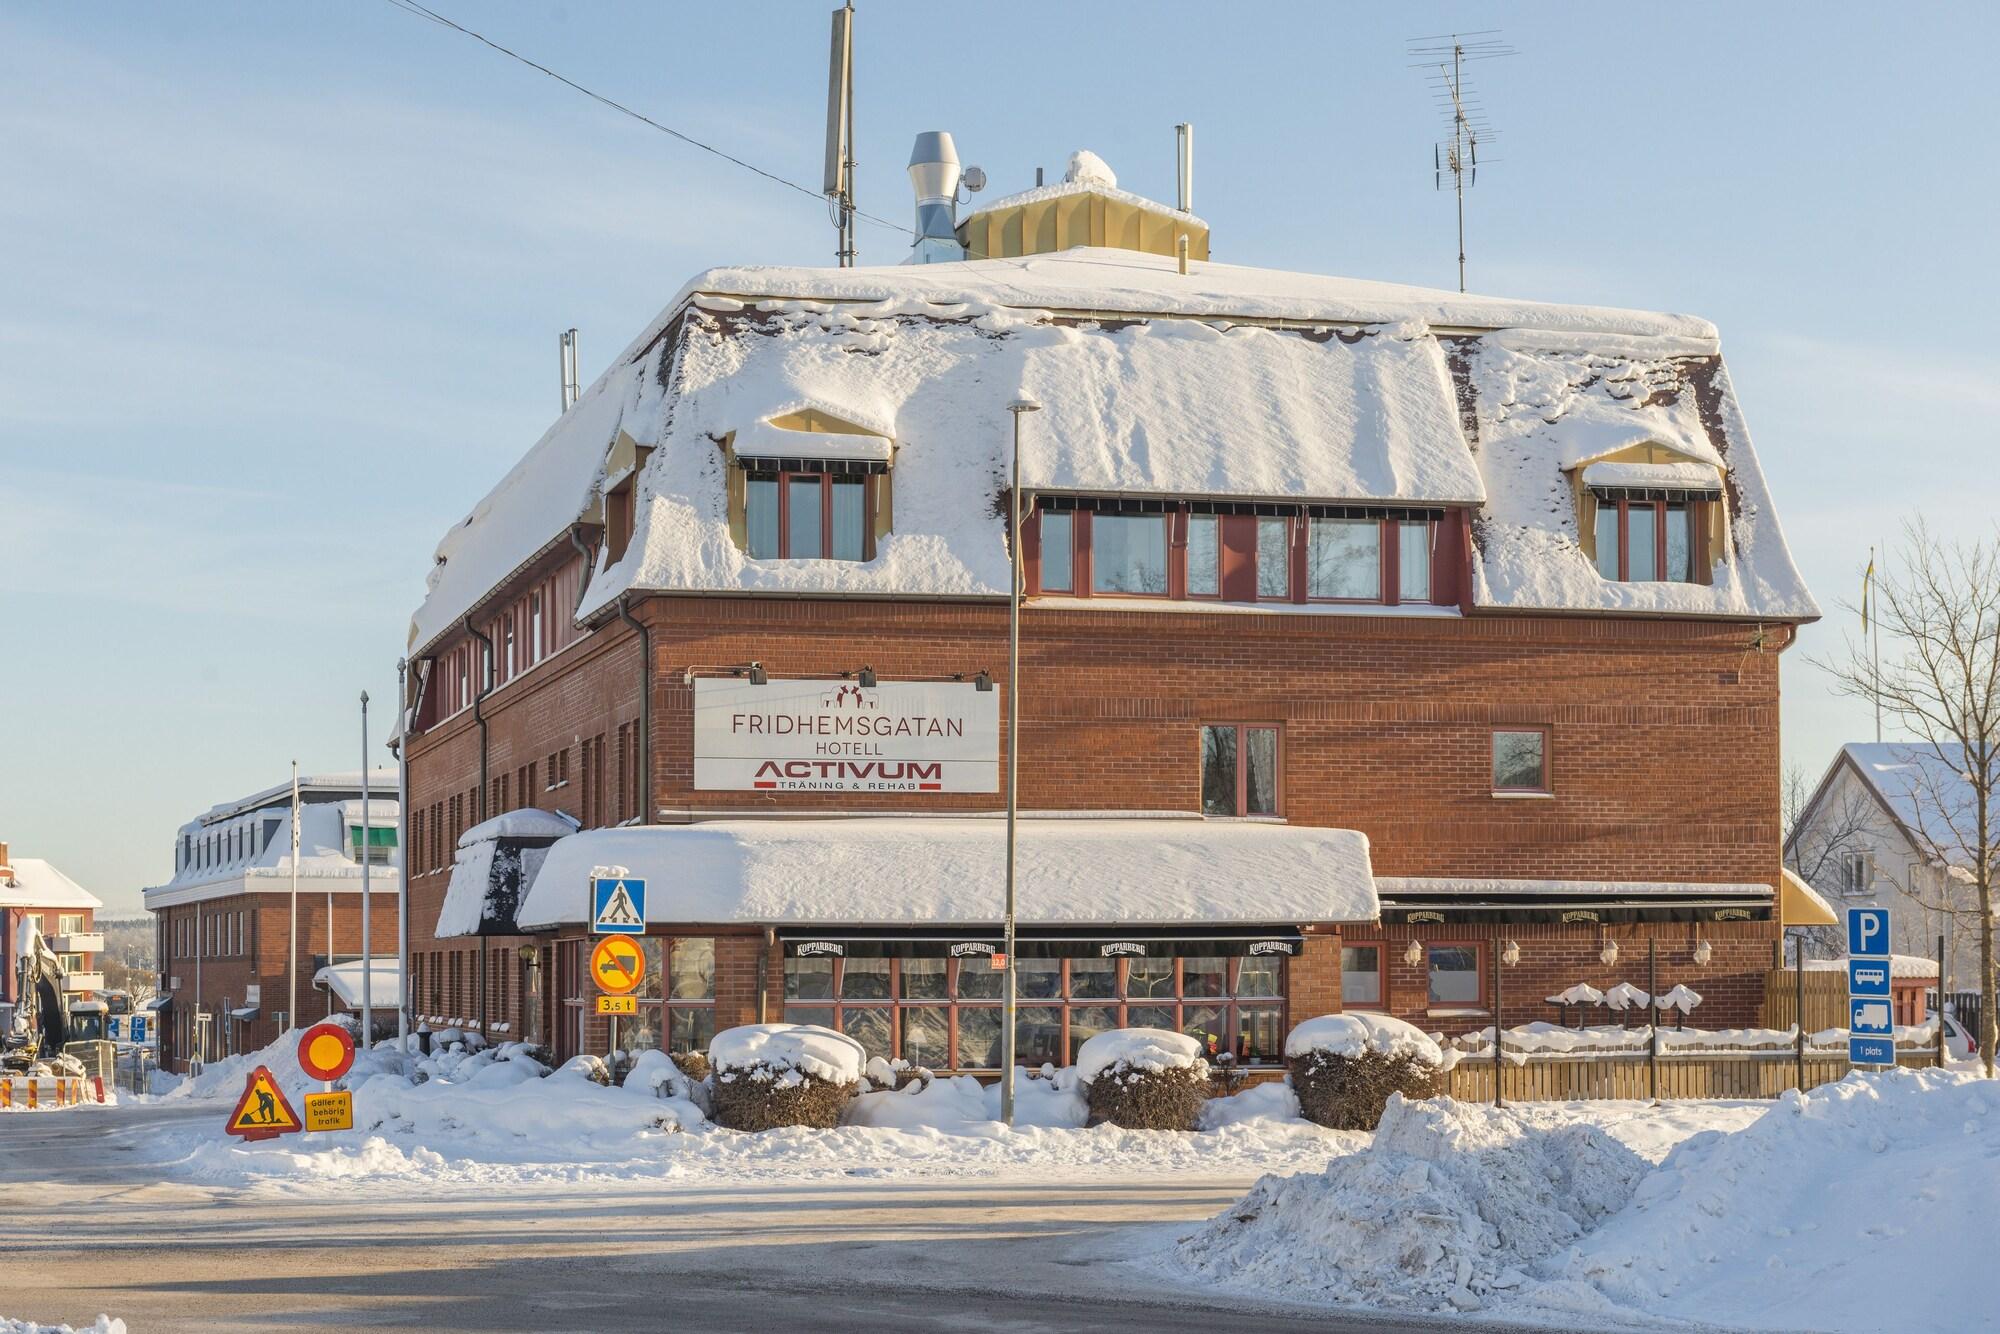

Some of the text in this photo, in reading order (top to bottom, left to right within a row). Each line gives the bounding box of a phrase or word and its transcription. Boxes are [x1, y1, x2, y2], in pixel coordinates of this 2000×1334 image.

[732, 714, 963, 737] FRIDHEMSGATAN
[816, 742, 884, 756] HOTELL
[754, 760, 942, 780] ACTIVUM
[779, 780, 916, 791] TRÄNING & REHAB
[1407, 911, 1445, 924] KOPPARBERG
[1562, 910, 1599, 923] KOPPARBERG
[1714, 908, 1751, 921] KOPPARBERG
[1860, 912, 1880, 951] P
[797, 941, 843, 956] KOPPARBERG
[950, 942, 996, 957] KOPPARBERG
[1101, 942, 1146, 957] KOPPARBERG
[1249, 941, 1293, 956] KOPPARBERG
[135, 1017, 143, 1028] P
[1865, 1046, 1882, 1056] plats
[313, 1108, 345, 1116] behörig
[318, 1117, 340, 1125] trafik
